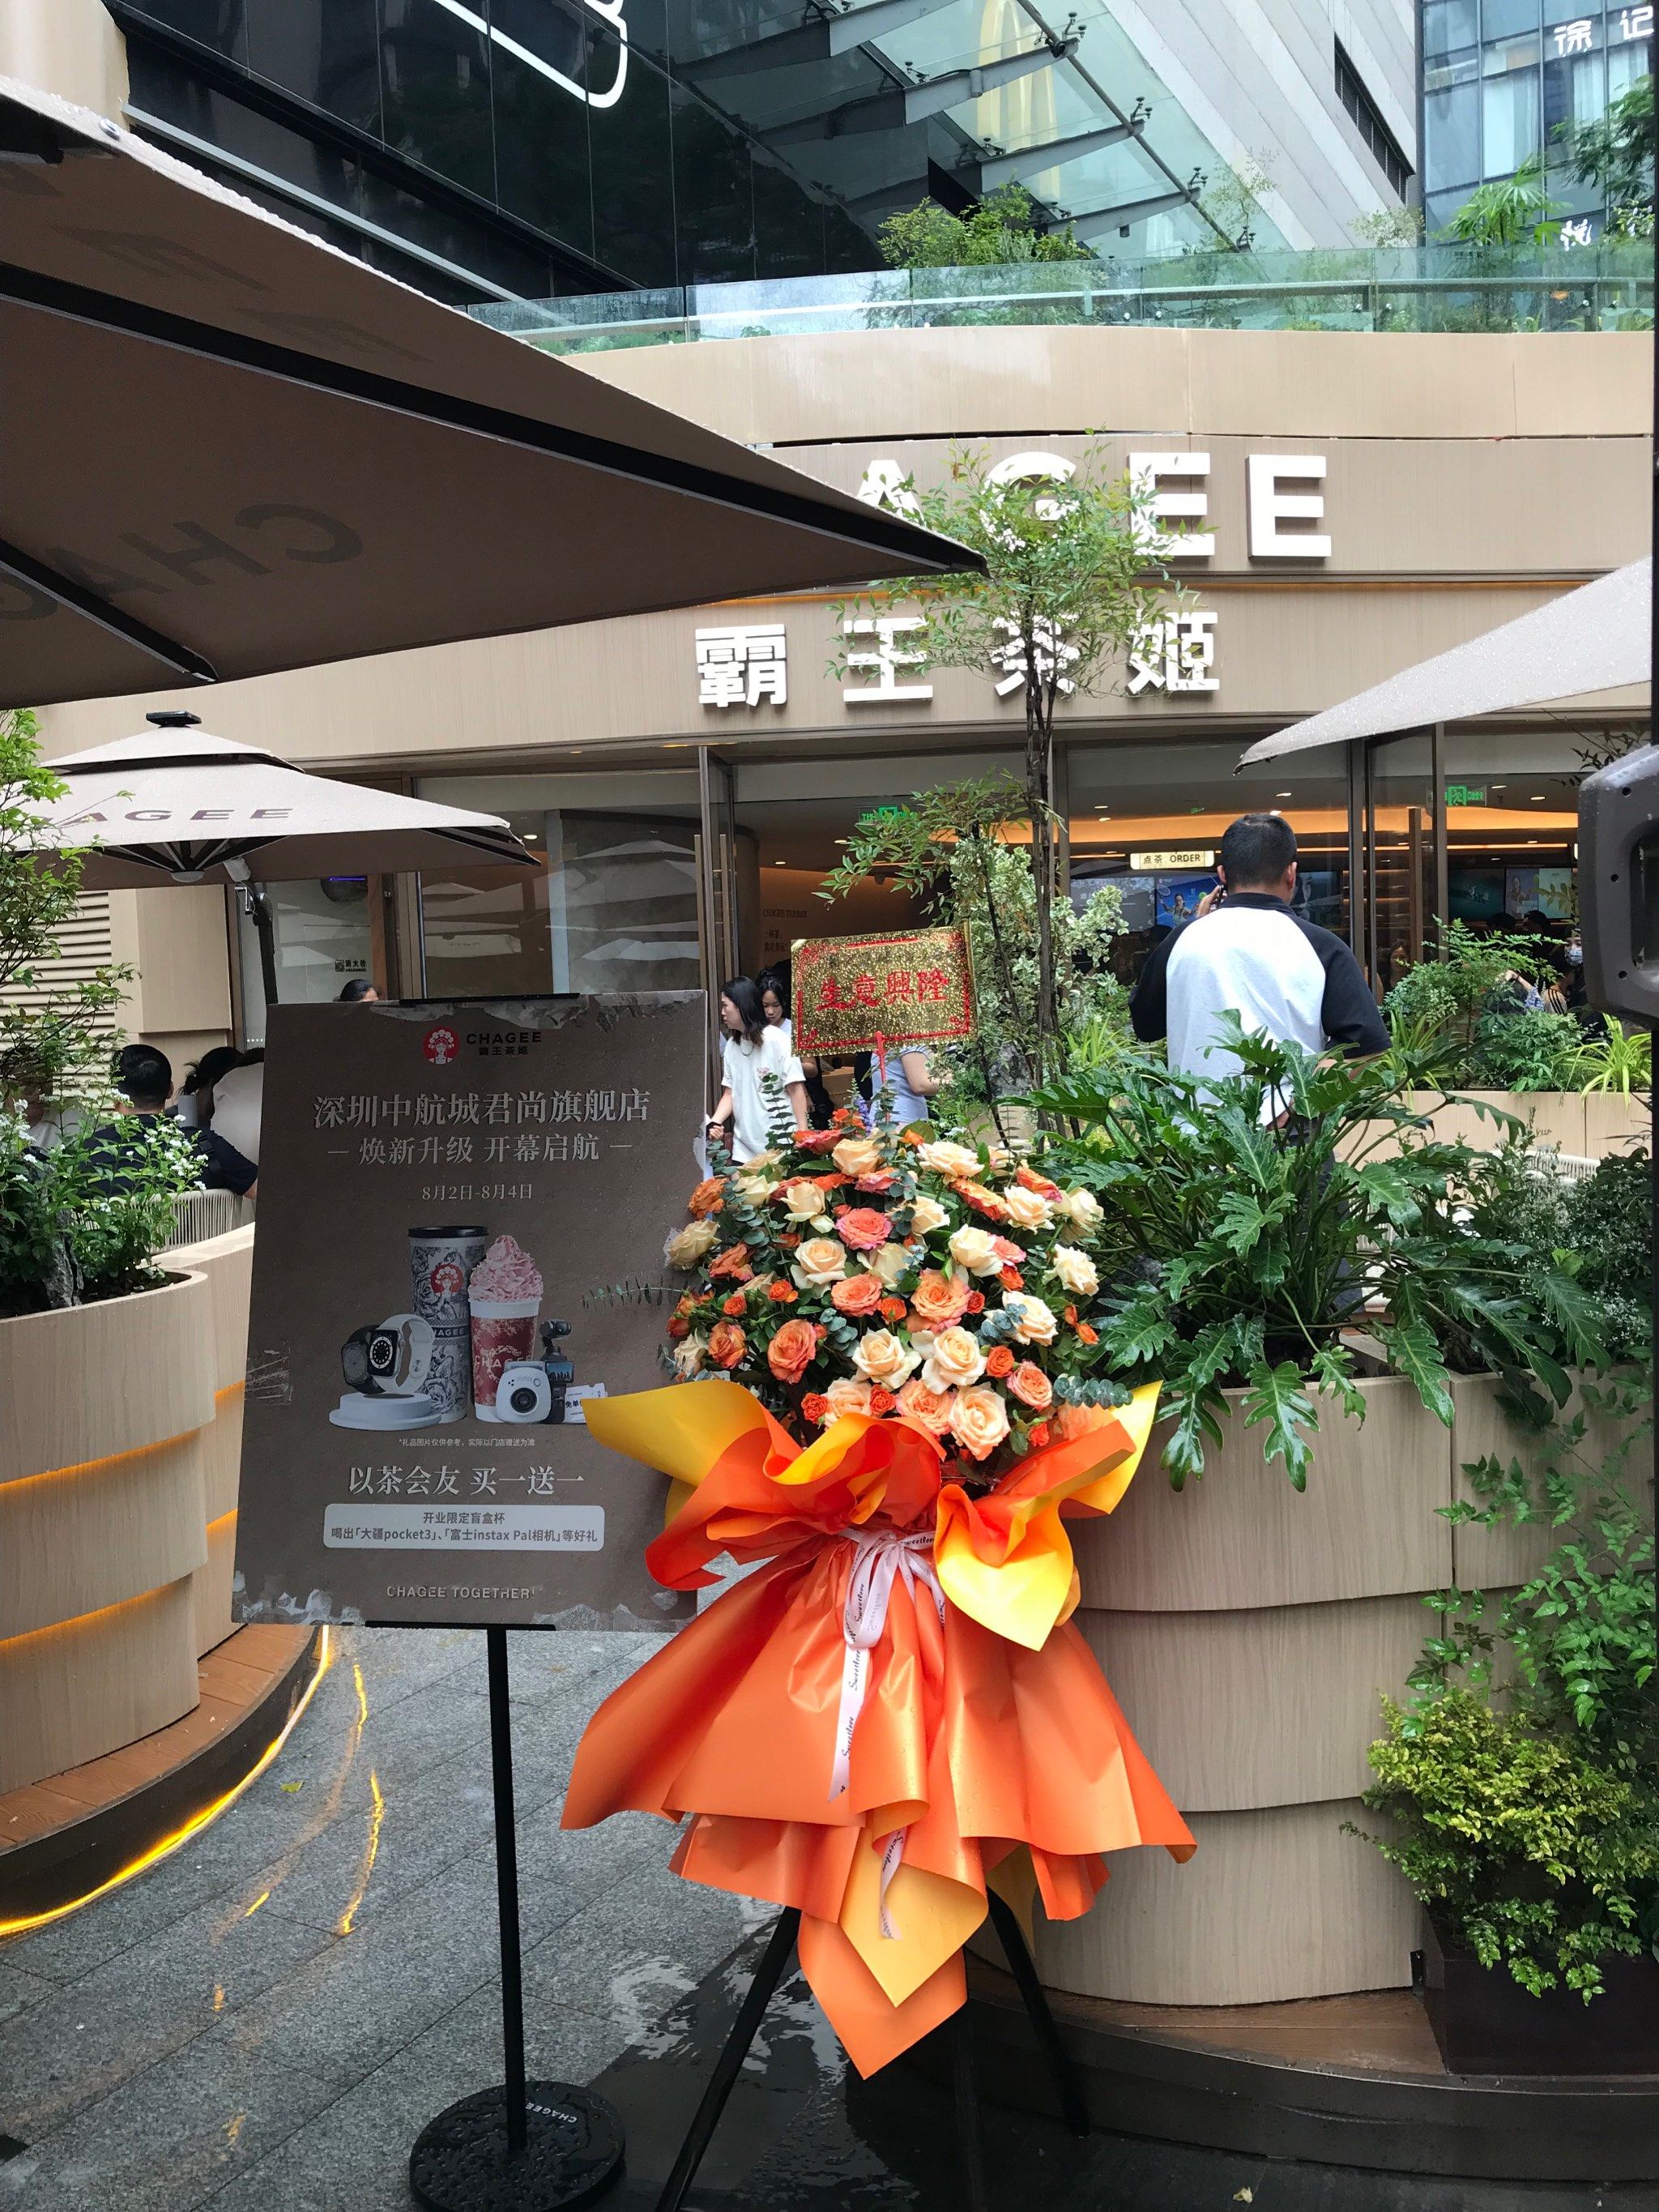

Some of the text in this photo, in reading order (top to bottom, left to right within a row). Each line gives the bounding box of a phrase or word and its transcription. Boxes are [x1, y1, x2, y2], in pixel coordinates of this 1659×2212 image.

[1170, 854, 1201, 863] ORDER
[466, 1031, 542, 1045] CHAGEE
[313, 1087, 650, 1129] 深圳中航城君尚旗舰店
[358, 1134, 599, 1166] 焕新升级 开幕启航
[421, 1183, 533, 1202] 8月2日-8月4日
[348, 1465, 585, 1496] 以茶会友 买一送一
[422, 1512, 505, 1525] 开业限定盲盒杯
[386, 1585, 446, 1599] CHAGEE
[854, 1583, 864, 1622] Sweetlove
[848, 1650, 861, 1692] Sweetlove
[525, 2102, 578, 2123] CHAGEE
